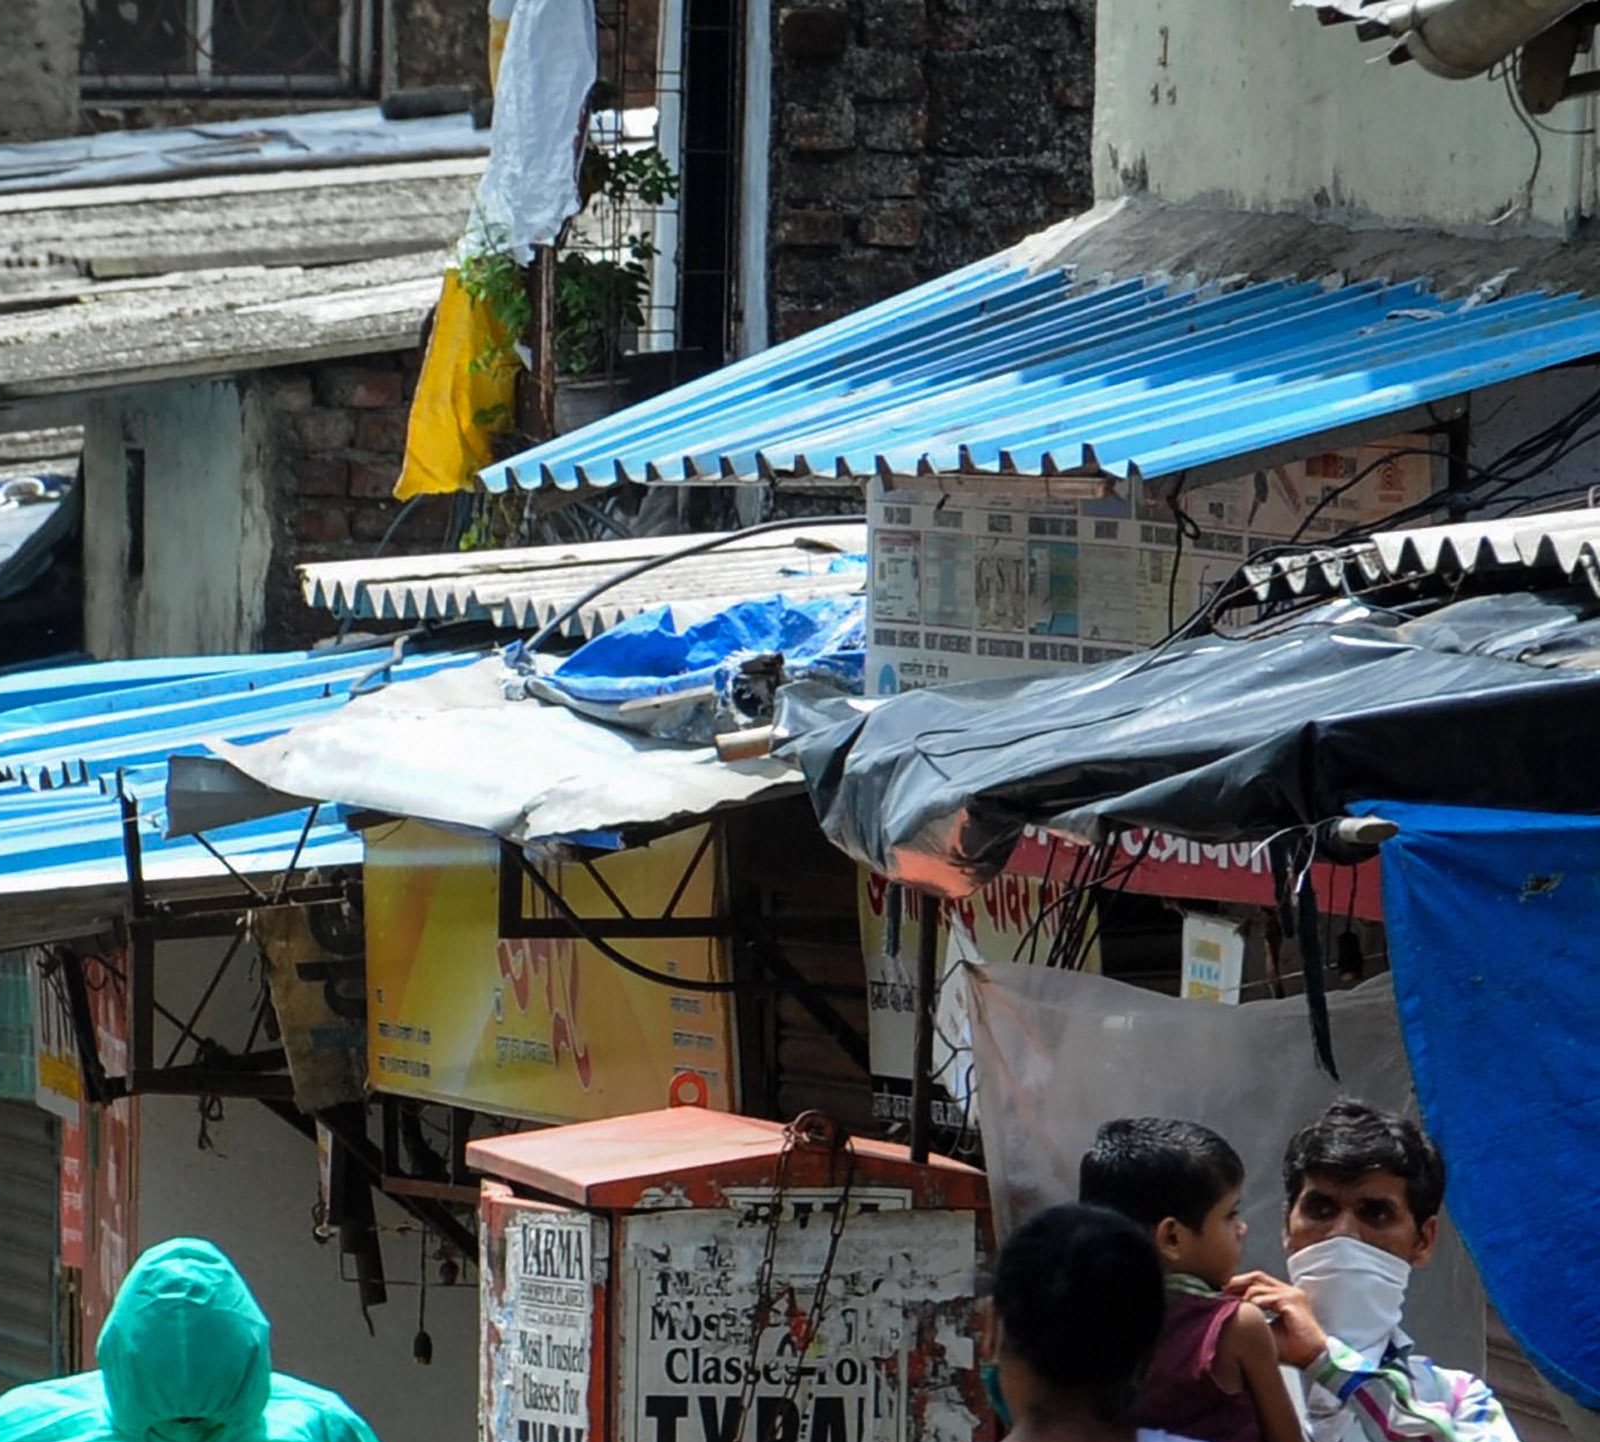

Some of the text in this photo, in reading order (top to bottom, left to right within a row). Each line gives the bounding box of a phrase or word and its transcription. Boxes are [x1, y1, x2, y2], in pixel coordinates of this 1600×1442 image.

[521, 1223, 585, 1281] VARMA
[545, 1334, 585, 1373] Trusted
[665, 1347, 801, 1386] Classes
[522, 1372, 580, 1415] Classes For
